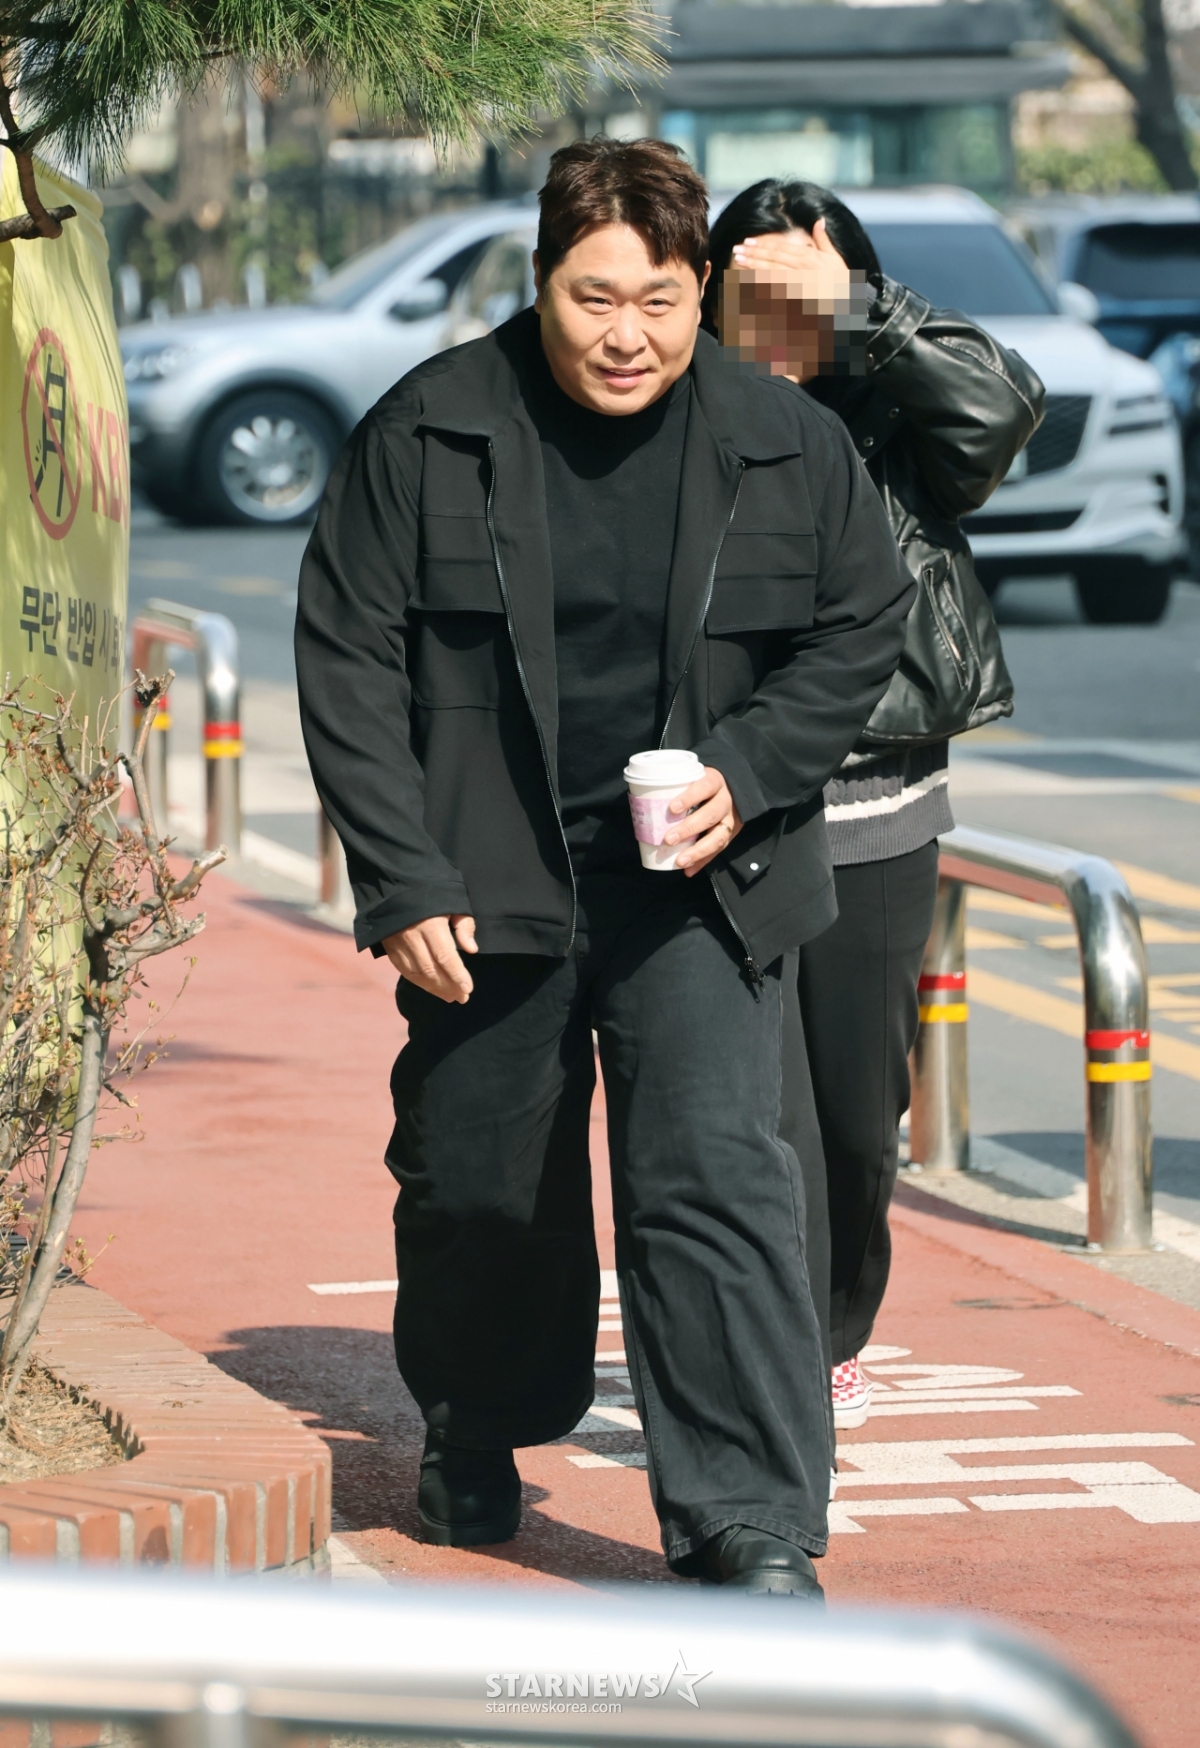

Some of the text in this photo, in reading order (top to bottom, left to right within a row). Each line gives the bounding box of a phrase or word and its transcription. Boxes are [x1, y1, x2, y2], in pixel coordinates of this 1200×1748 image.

[20, 586, 61, 657] 무단
[67, 597, 96, 668] 반입
[99, 608, 110, 673] 시
